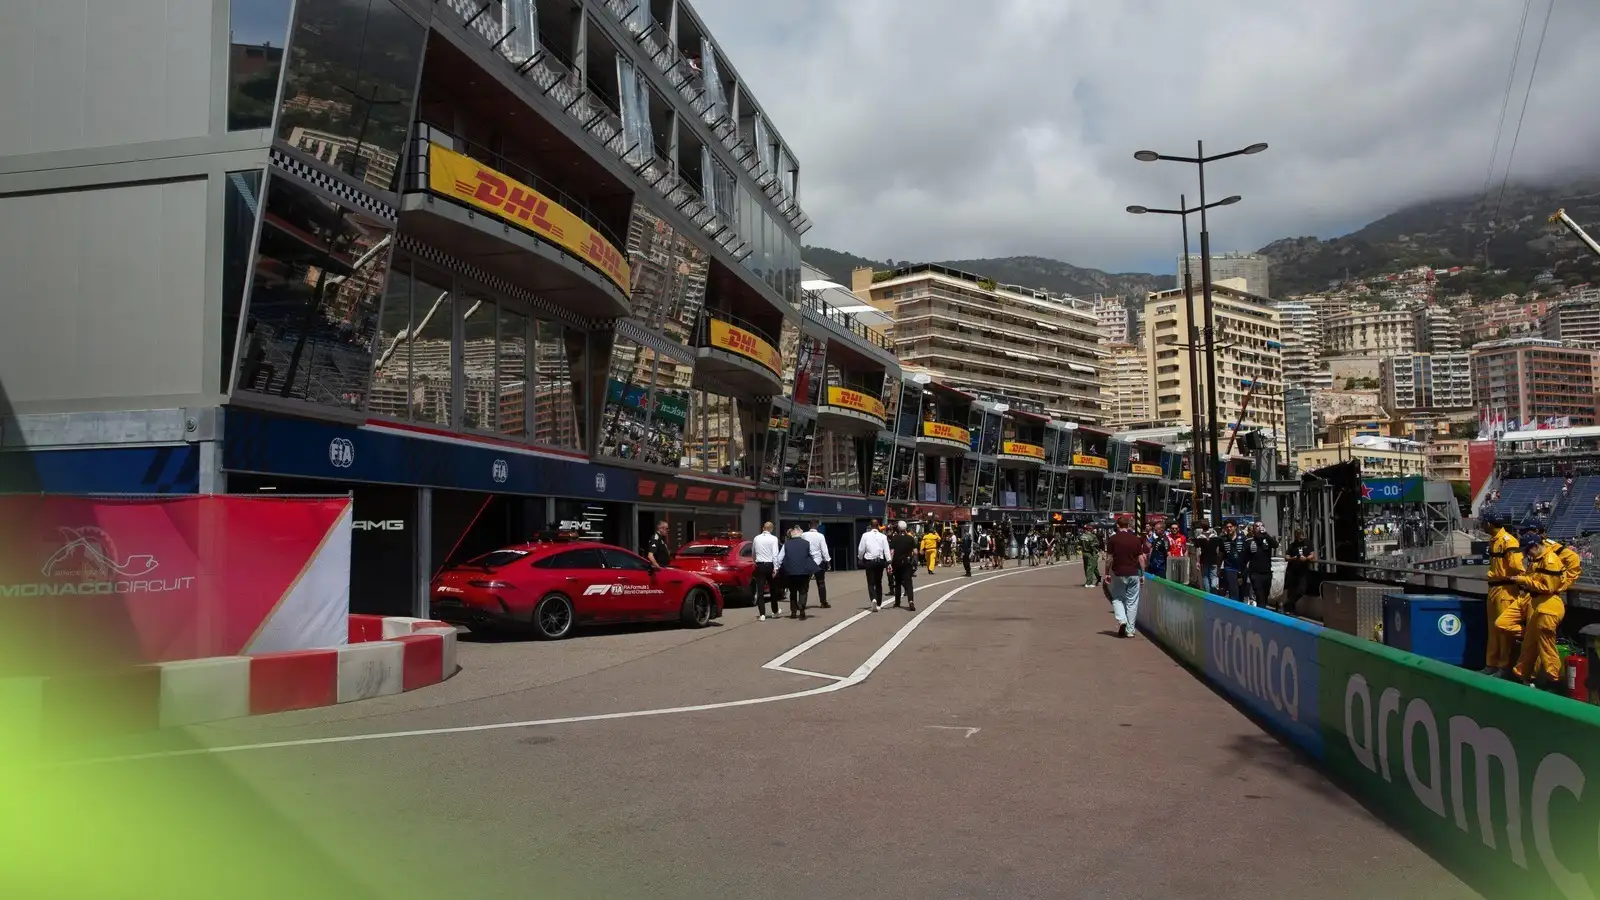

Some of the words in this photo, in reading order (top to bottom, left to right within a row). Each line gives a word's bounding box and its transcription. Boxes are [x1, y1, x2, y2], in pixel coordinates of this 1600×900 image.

[472, 169, 552, 233] DHL
[589, 233, 624, 282] DHL
[728, 328, 758, 356] DHL
[841, 390, 864, 408] DHL
[331, 443, 352, 462] FIA
[352, 520, 404, 531] AMG
[570, 520, 591, 530] AMG
[1212, 617, 1299, 721] aramco
[1344, 673, 1600, 900] aramc
